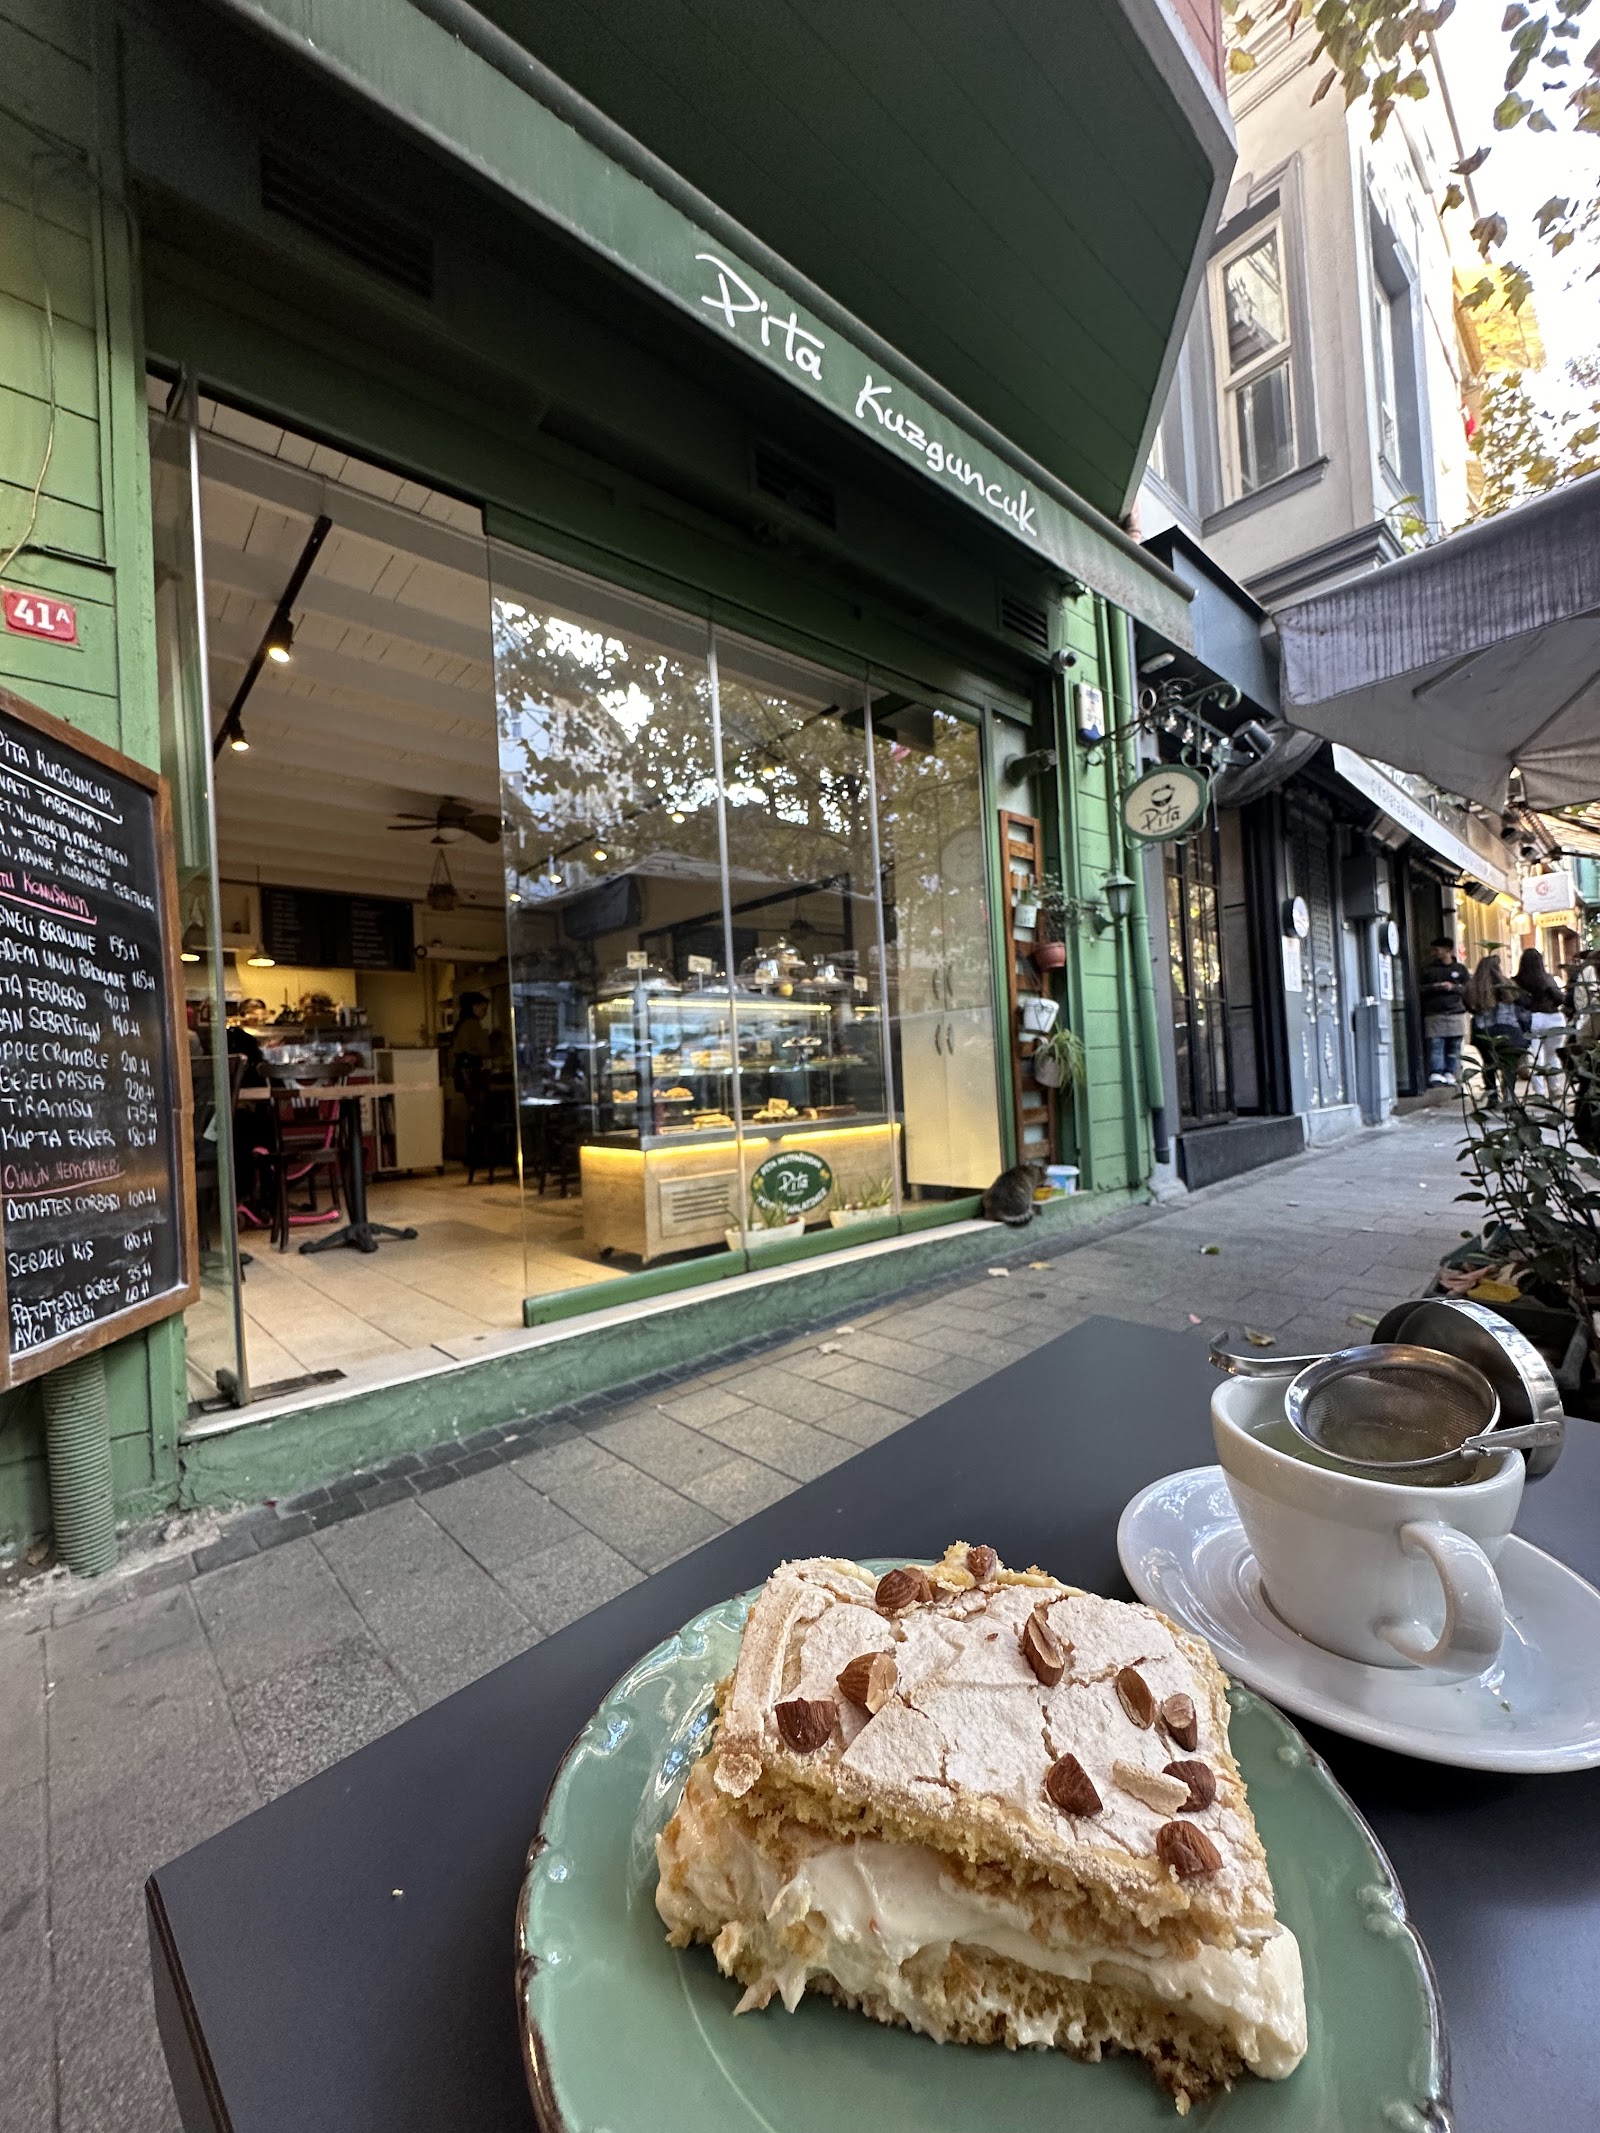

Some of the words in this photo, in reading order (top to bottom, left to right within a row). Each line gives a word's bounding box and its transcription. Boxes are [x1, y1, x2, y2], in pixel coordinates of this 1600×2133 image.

[855, 374, 1037, 536] Kuzguncuk
[27, 976, 87, 1011] FERRERO
[0, 1040, 40, 1063] PPLE
[57, 1069, 106, 1091] PASTA
